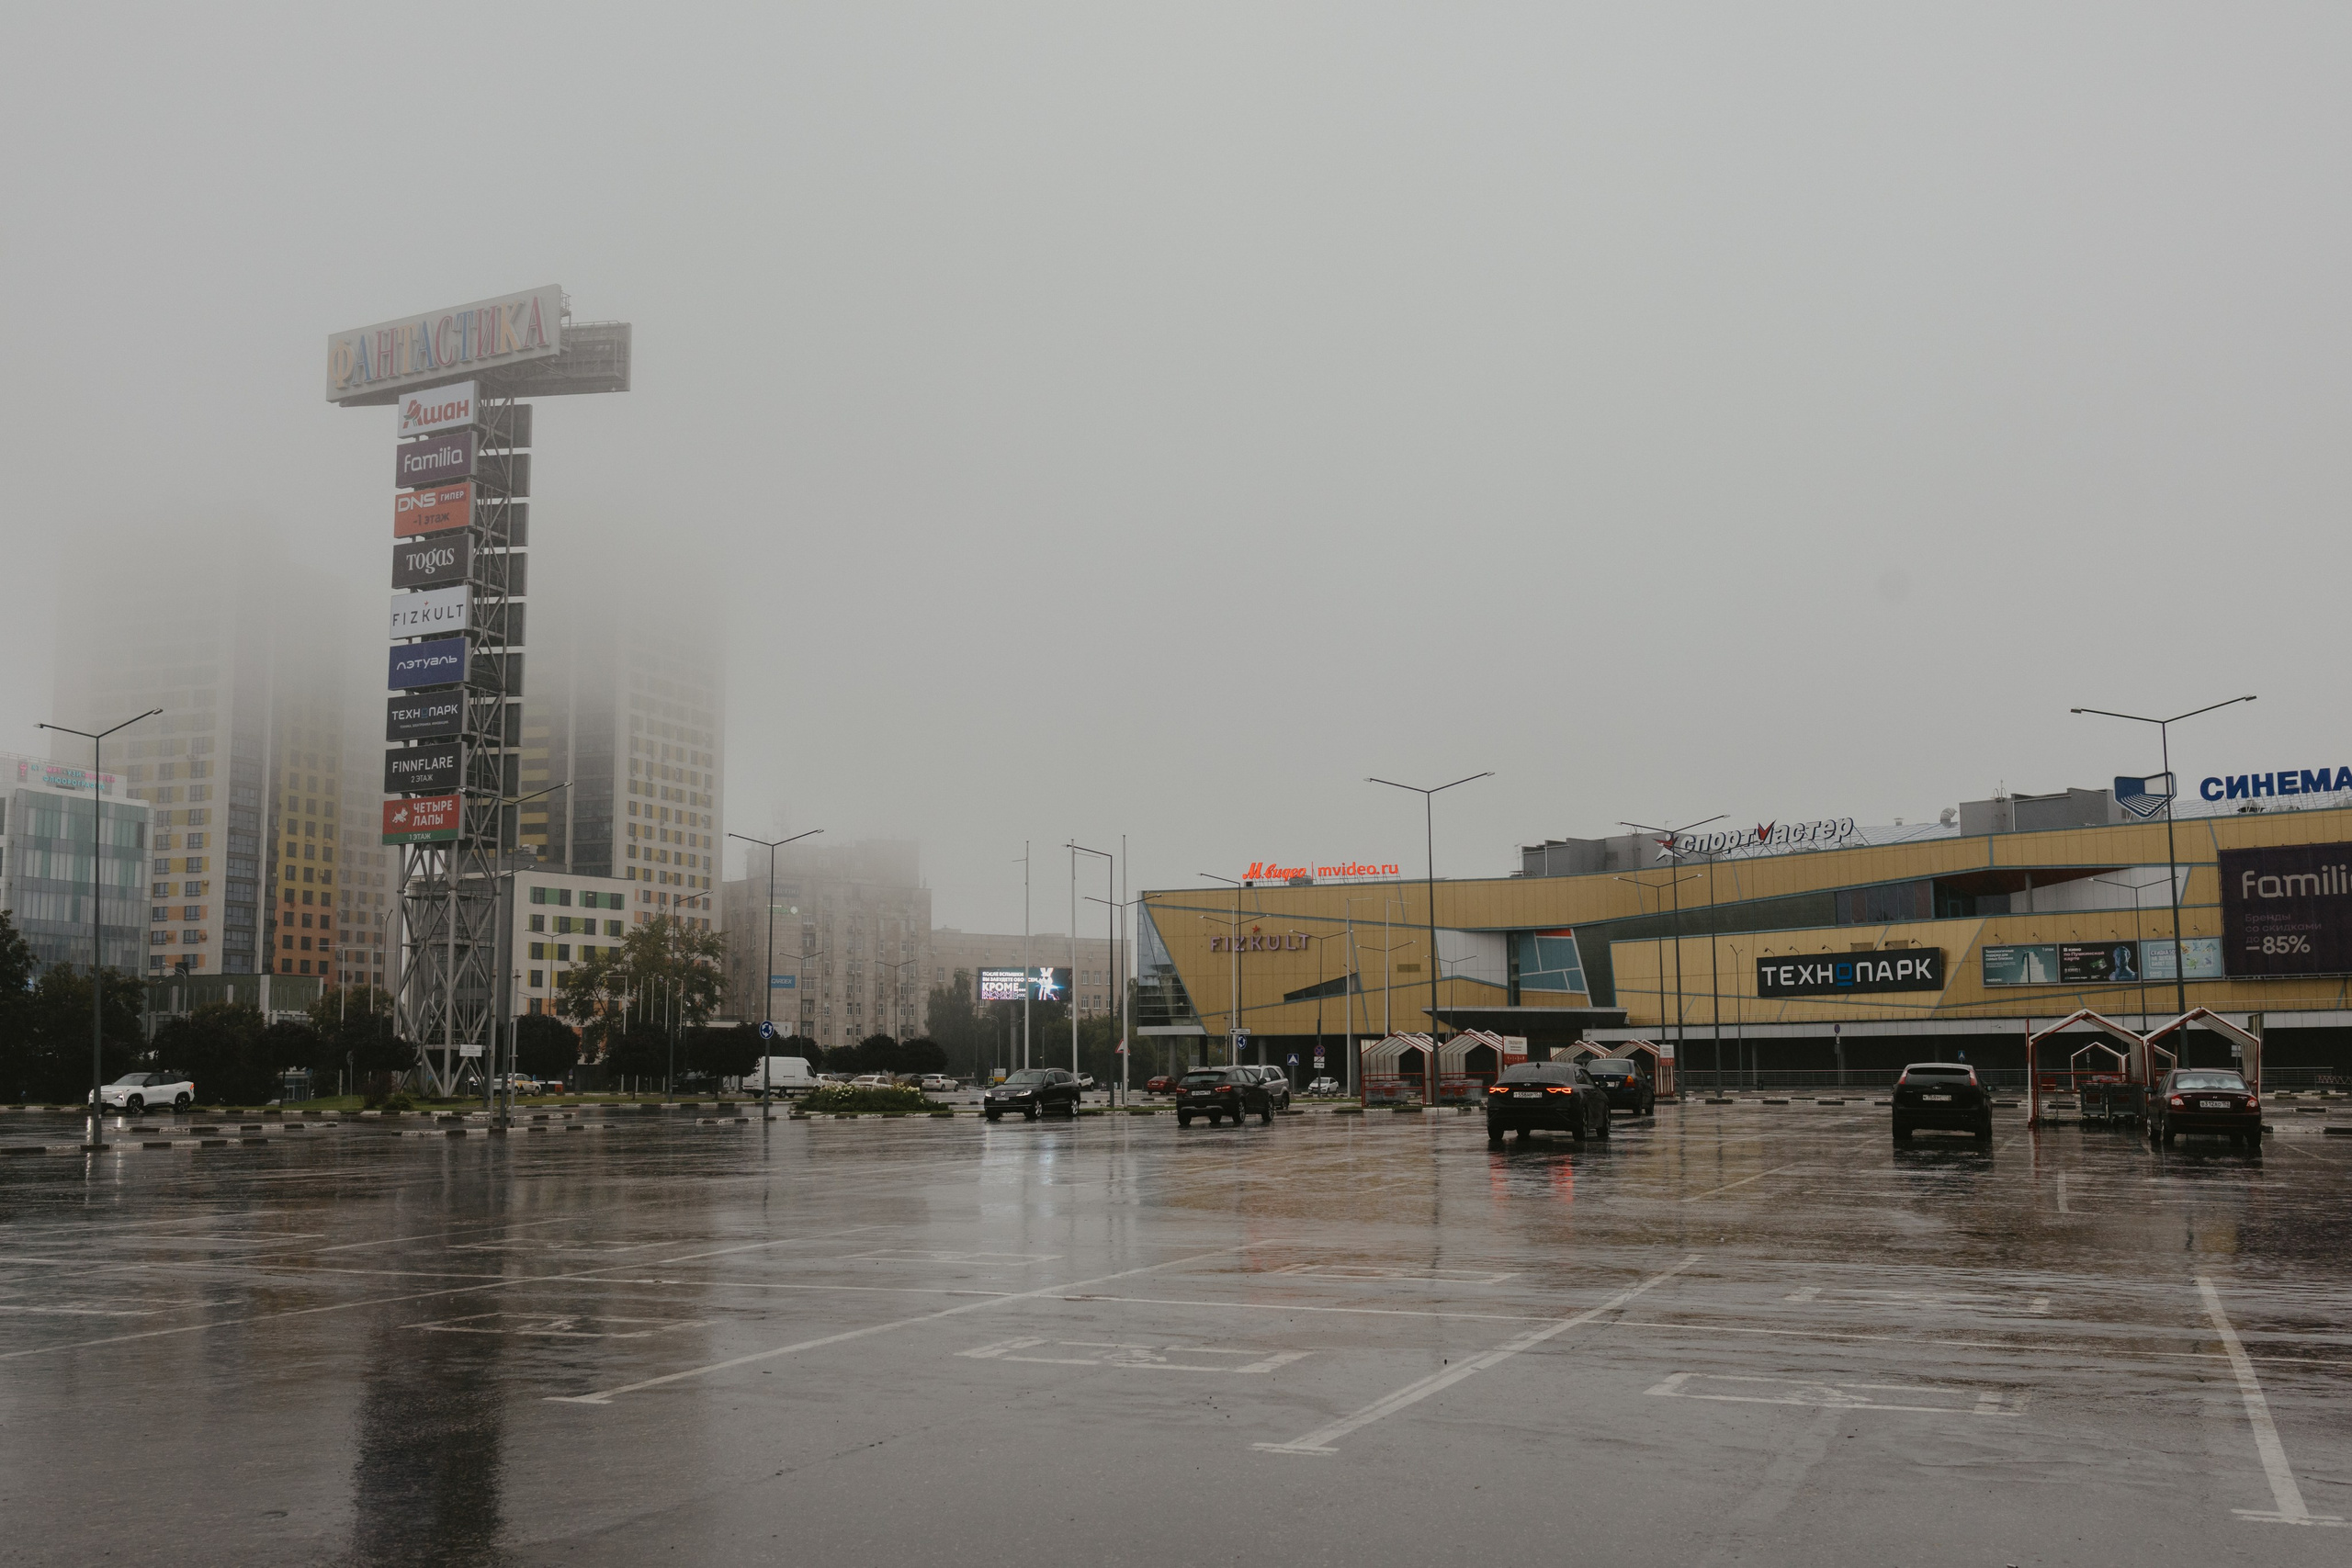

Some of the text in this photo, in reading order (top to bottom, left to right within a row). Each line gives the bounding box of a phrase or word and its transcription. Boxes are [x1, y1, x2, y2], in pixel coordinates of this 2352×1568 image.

[328, 295, 549, 389] ФАНТАСТИКА
[402, 399, 469, 429] Ашан
[398, 491, 436, 513] DNS
[440, 490, 465, 502] ГИПЕР
[424, 512, 449, 525] этаж
[392, 604, 463, 626] FIZKULT
[391, 704, 458, 721] ТЕХНОПАРК
[392, 755, 454, 773] FINNFLARE
[67, 769, 82, 777] УЗИ
[411, 774, 434, 784] 2 ЭТАЖ
[2199, 766, 2352, 801] СИНЕМА
[413, 799, 453, 814] ЧЕТЫРЕ
[413, 814, 444, 827] ЛАПЫ
[412, 832, 431, 840] ЭТАЖ
[1317, 862, 1398, 877] mvideo.ru
[2241, 863, 2352, 899] famili
[2245, 914, 2291, 923] Бренды
[2262, 922, 2322, 931] скидками
[1210, 934, 1310, 953] FIZKULT
[2245, 936, 2260, 944] до
[1761, 958, 1933, 987] ТЕХНОПАРК
